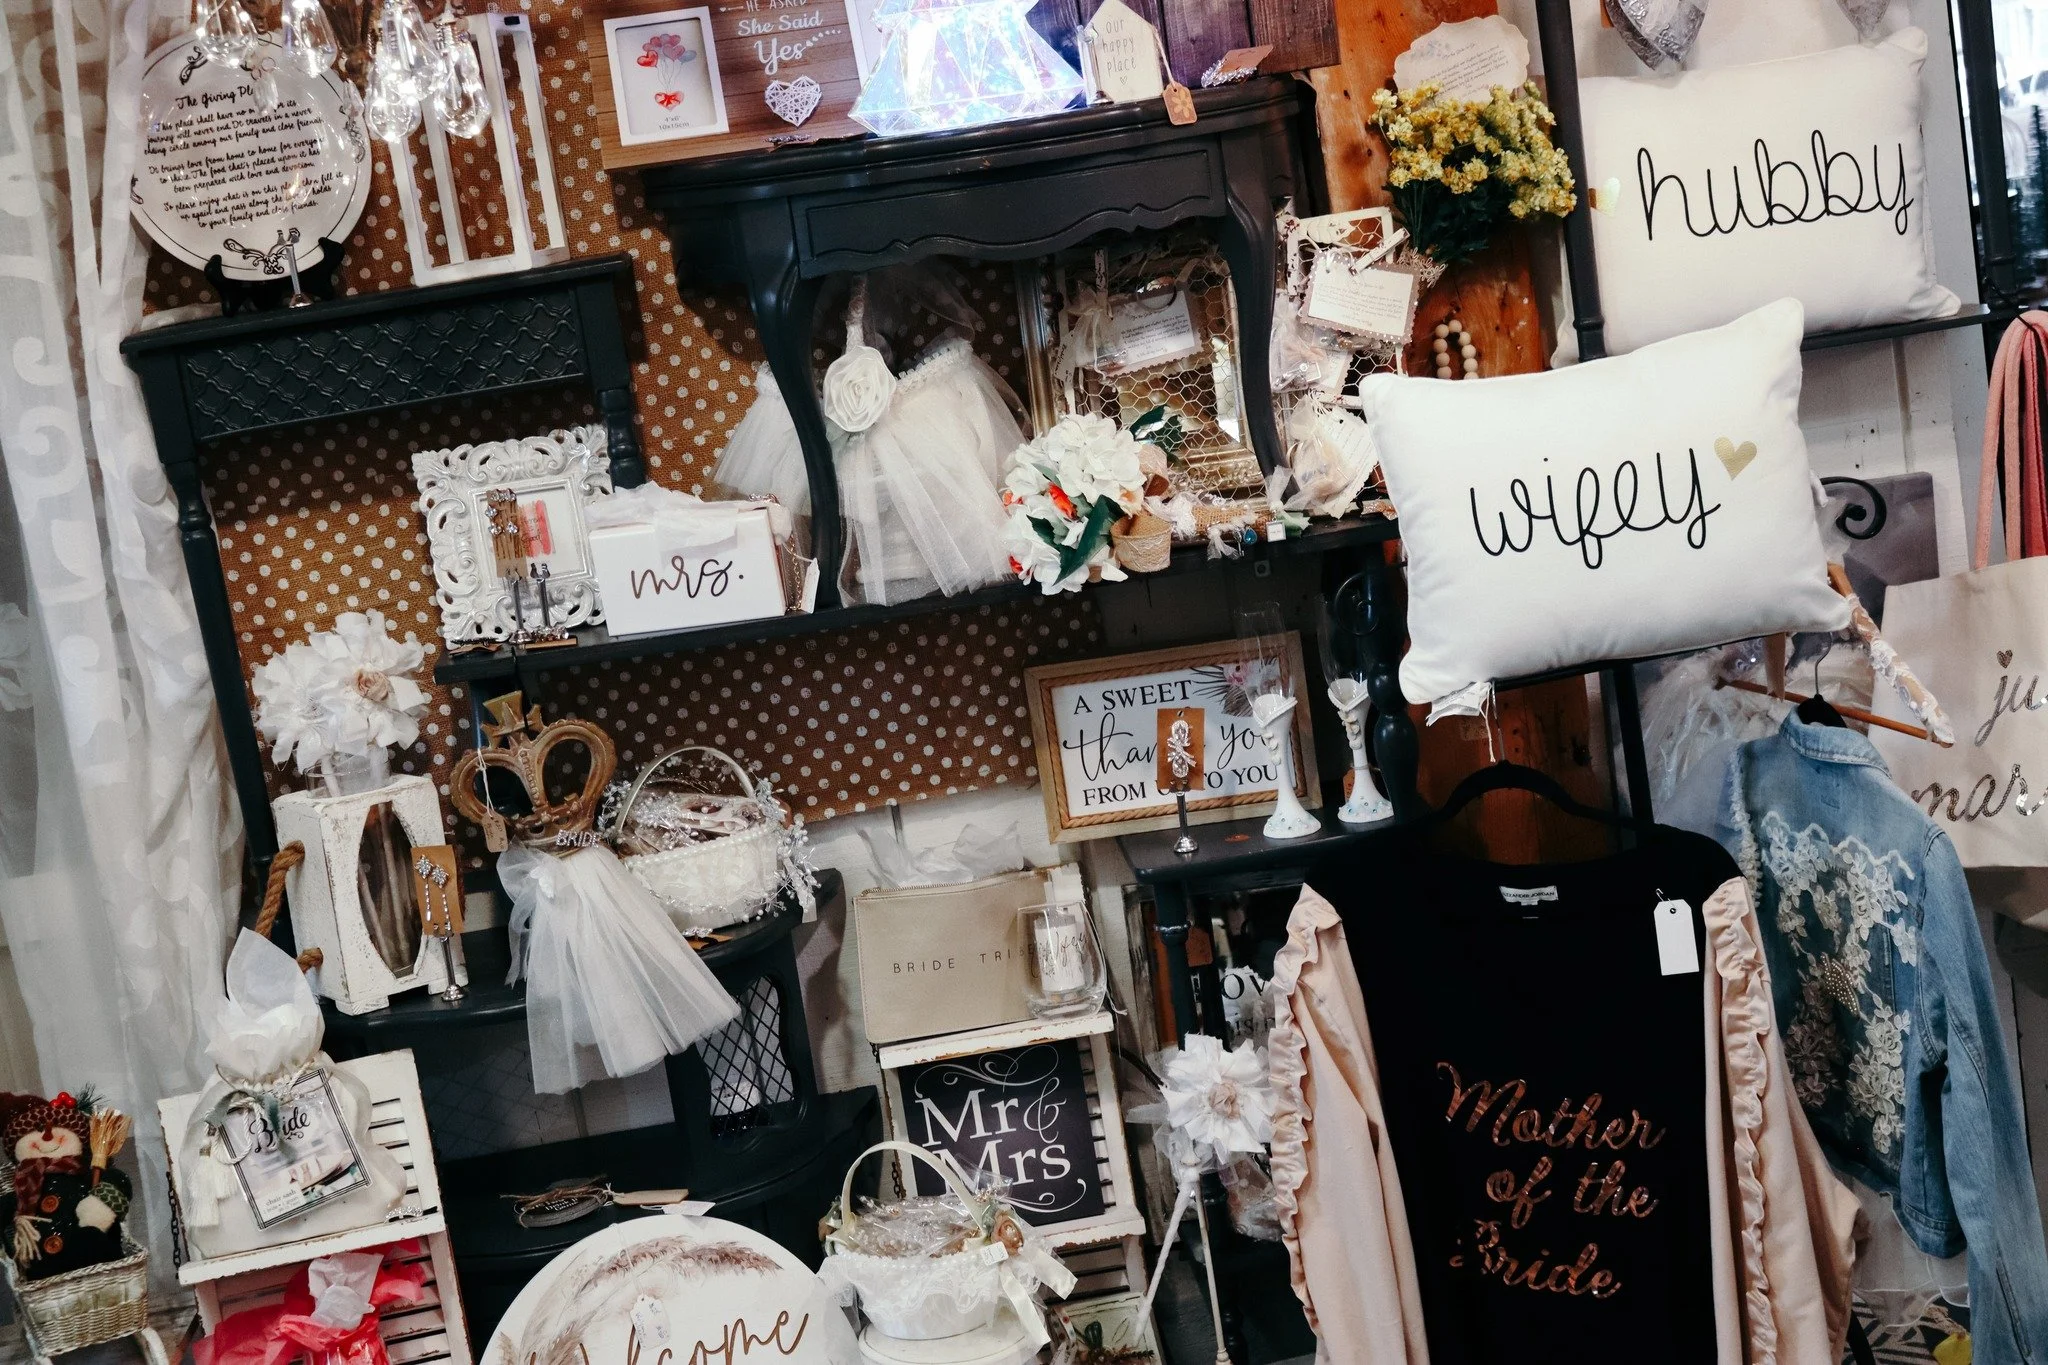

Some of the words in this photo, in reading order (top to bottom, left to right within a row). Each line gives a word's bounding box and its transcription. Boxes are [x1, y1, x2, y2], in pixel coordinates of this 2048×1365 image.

[738, 18, 775, 36] She
[778, 10, 824, 31] Said
[746, 0, 760, 13] HE
[753, 37, 807, 76] Yes
[1101, 37, 1135, 56] happy
[1106, 57, 1137, 77] place
[175, 95, 198, 109] The
[201, 90, 236, 109] Giving
[196, 114, 214, 125] shall
[216, 111, 234, 120] have
[287, 99, 297, 107] its
[147, 135, 175, 144] journey
[177, 129, 191, 139] will
[193, 126, 215, 136] never
[231, 119, 244, 129] It
[245, 115, 272, 125] travels
[274, 113, 282, 121] in
[291, 106, 313, 117] never
[169, 141, 190, 153] circle
[192, 138, 217, 148] among
[235, 127, 260, 143] family
[261, 125, 276, 134] and
[278, 122, 295, 131] close
[148, 165, 159, 175] It
[160, 163, 185, 173] brings
[187, 160, 203, 169] love
[205, 156, 225, 169] from
[226, 152, 245, 161] home
[258, 145, 277, 155] home
[279, 141, 293, 154] for
[293, 138, 323, 149] everyo
[159, 176, 168, 184] to
[191, 168, 208, 179] The
[209, 165, 227, 179] food
[228, 161, 250, 172] that's
[252, 156, 276, 170] placed
[277, 153, 298, 165] upon
[299, 150, 307, 158] it
[308, 147, 321, 156] has
[163, 201, 174, 212] So
[175, 201, 197, 213] please
[198, 197, 220, 213] enjoy
[222, 192, 241, 202] what
[242, 190, 249, 198] is
[263, 184, 278, 194] this
[321, 171, 333, 185] fill
[173, 184, 191, 193] been
[193, 176, 227, 193] prepared
[228, 172, 246, 183] with
[247, 171, 263, 179] love
[265, 166, 280, 176] and
[1637, 128, 1915, 241] hubby
[180, 213, 190, 221] up
[191, 210, 213, 221] again
[214, 205, 229, 214] and
[231, 202, 247, 213] pass
[248, 198, 269, 208] along
[271, 194, 283, 203] the
[312, 185, 332, 196] holds
[209, 216, 228, 230] your
[229, 210, 254, 226] family
[255, 207, 270, 217] and
[1469, 446, 1722, 570] wifey
[630, 554, 745, 600] mrs.
[1073, 694, 1093, 716] A
[1102, 679, 1193, 712] SWEET
[1974, 650, 2048, 748] ju
[1062, 711, 1158, 784] tha
[1083, 783, 1147, 808] FROM
[1231, 763, 1281, 786] YOU
[1911, 763, 2048, 823] mar
[555, 829, 602, 848] BRIDE
[1531, 891, 1555, 899] JORDAN
[892, 957, 956, 974] BRIDE
[914, 1087, 1020, 1148] Mr
[1022, 1076, 1068, 1144] &
[1436, 1060, 1667, 1150] Mother
[248, 1106, 311, 1154] Bide
[931, 1138, 1072, 1195] Mrs
[1485, 1155, 1553, 1230] of
[1573, 1159, 1660, 1219] the
[1449, 1217, 1623, 1299] Bride
